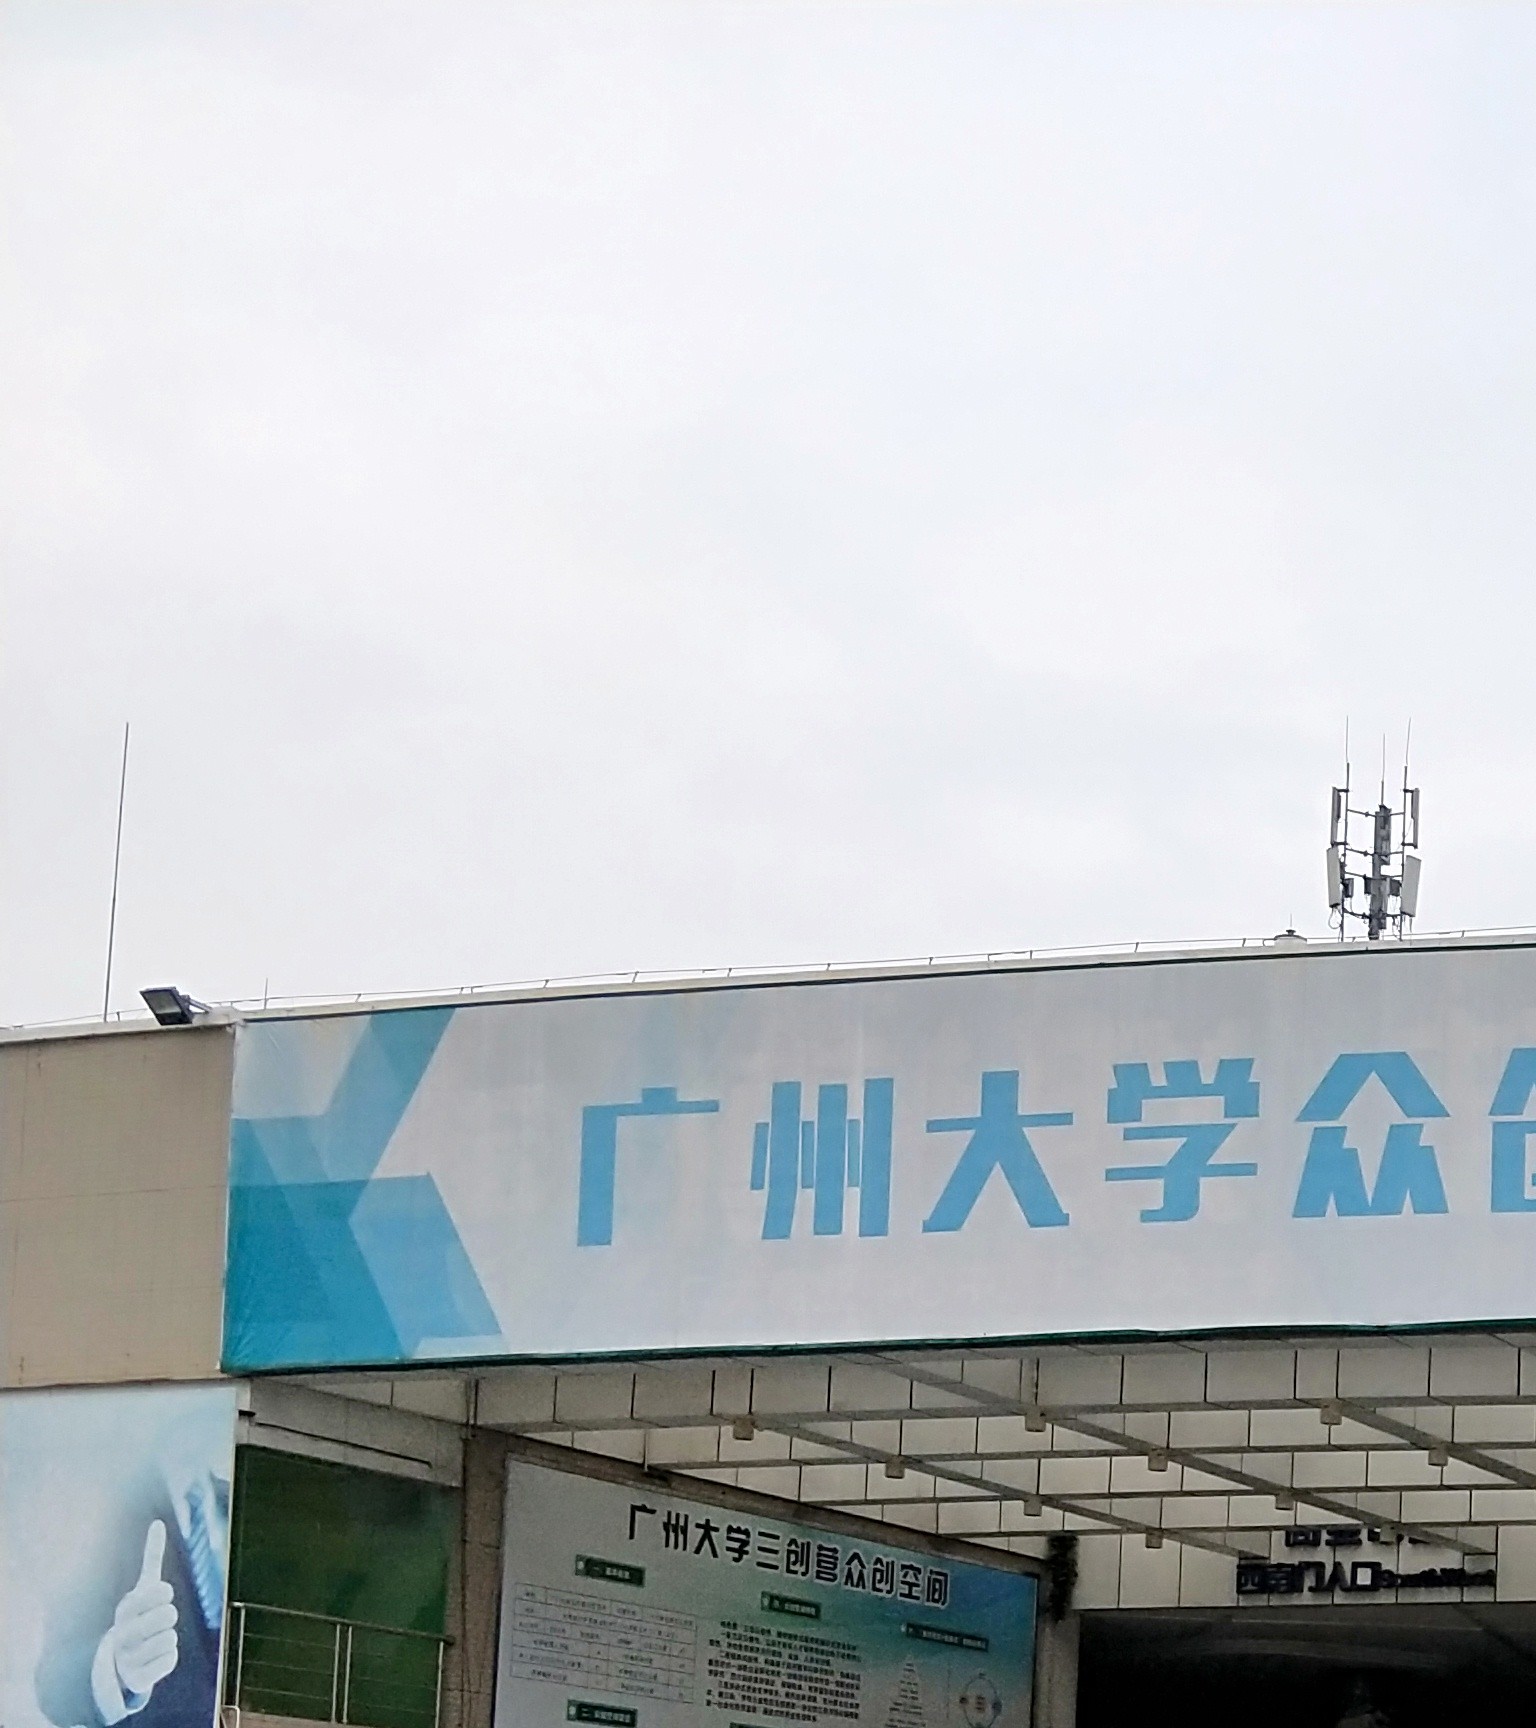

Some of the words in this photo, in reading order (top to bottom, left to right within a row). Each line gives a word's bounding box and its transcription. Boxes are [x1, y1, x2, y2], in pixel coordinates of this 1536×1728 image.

[628, 1502, 950, 1607] 广州大学三创营众创空间
